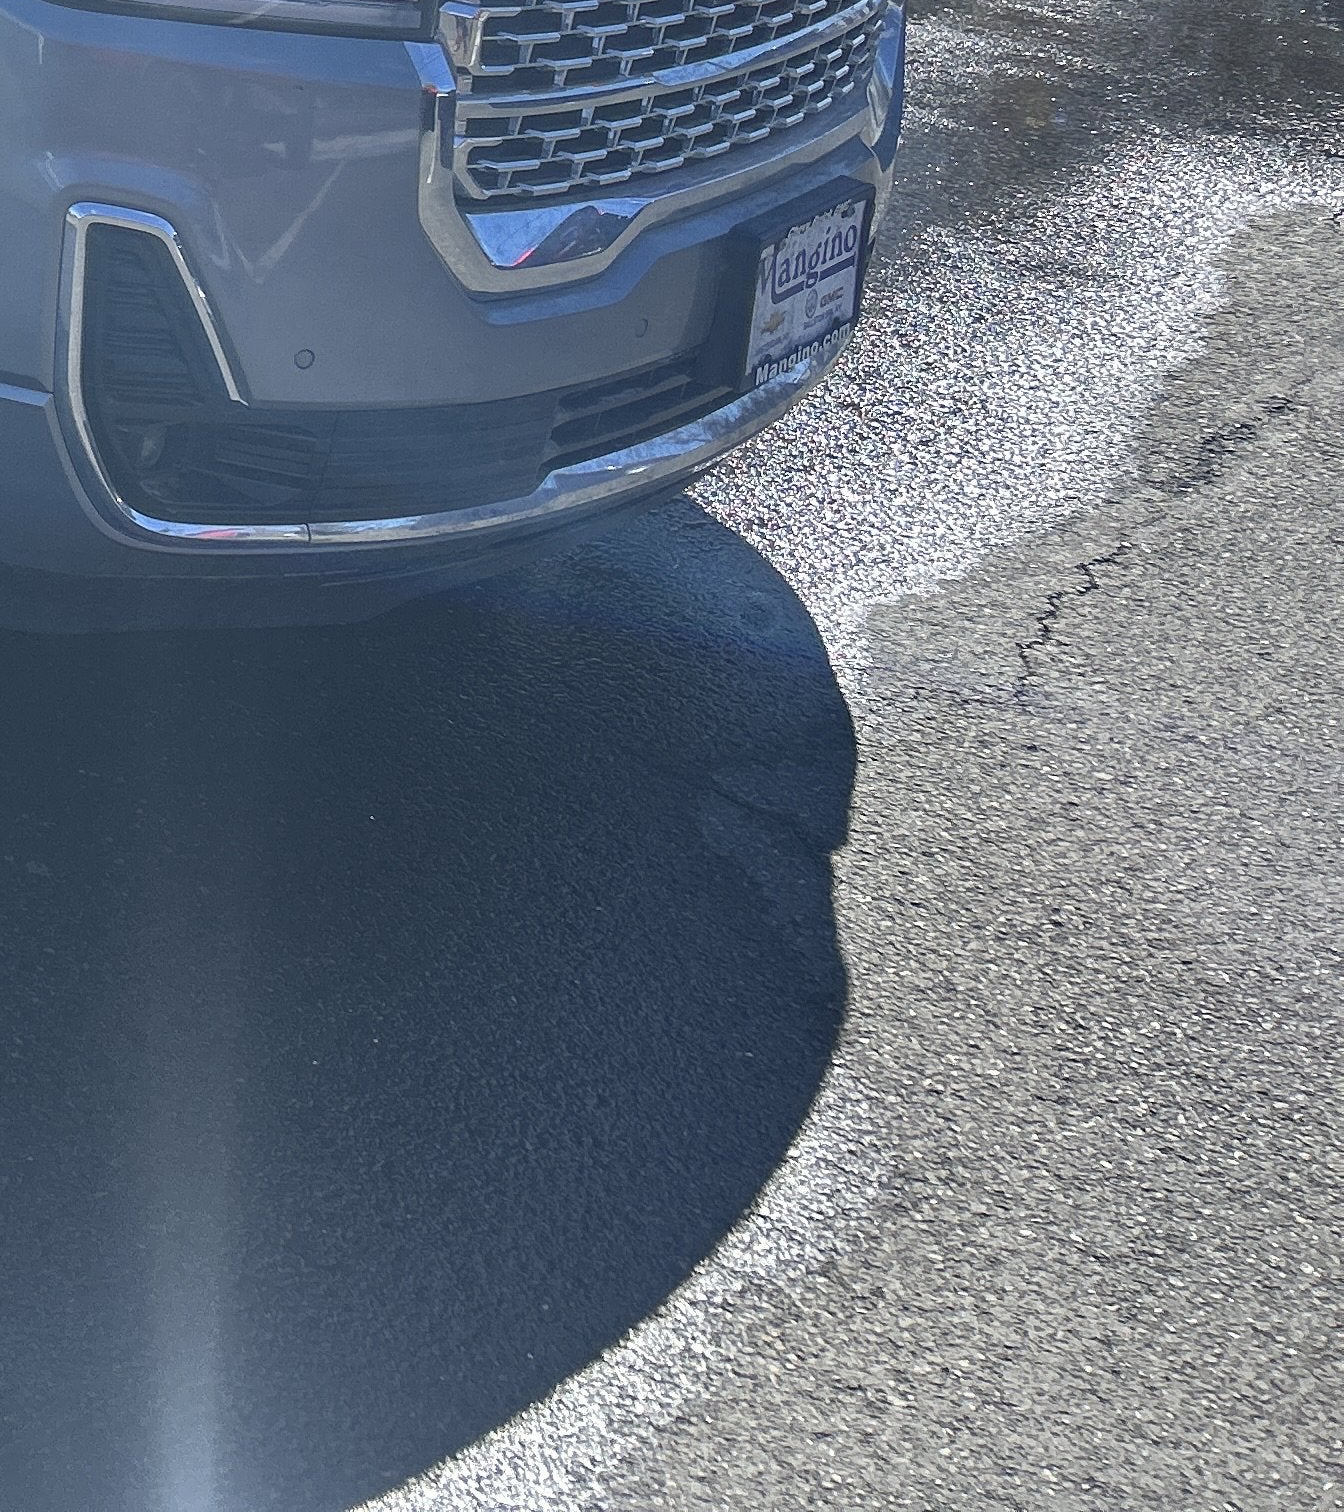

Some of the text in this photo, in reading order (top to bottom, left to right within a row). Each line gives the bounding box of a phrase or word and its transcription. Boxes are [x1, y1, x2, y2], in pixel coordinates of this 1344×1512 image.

[758, 223, 858, 305] Mangino
[819, 286, 845, 308] GMC
[755, 323, 851, 386] Mangino.com
